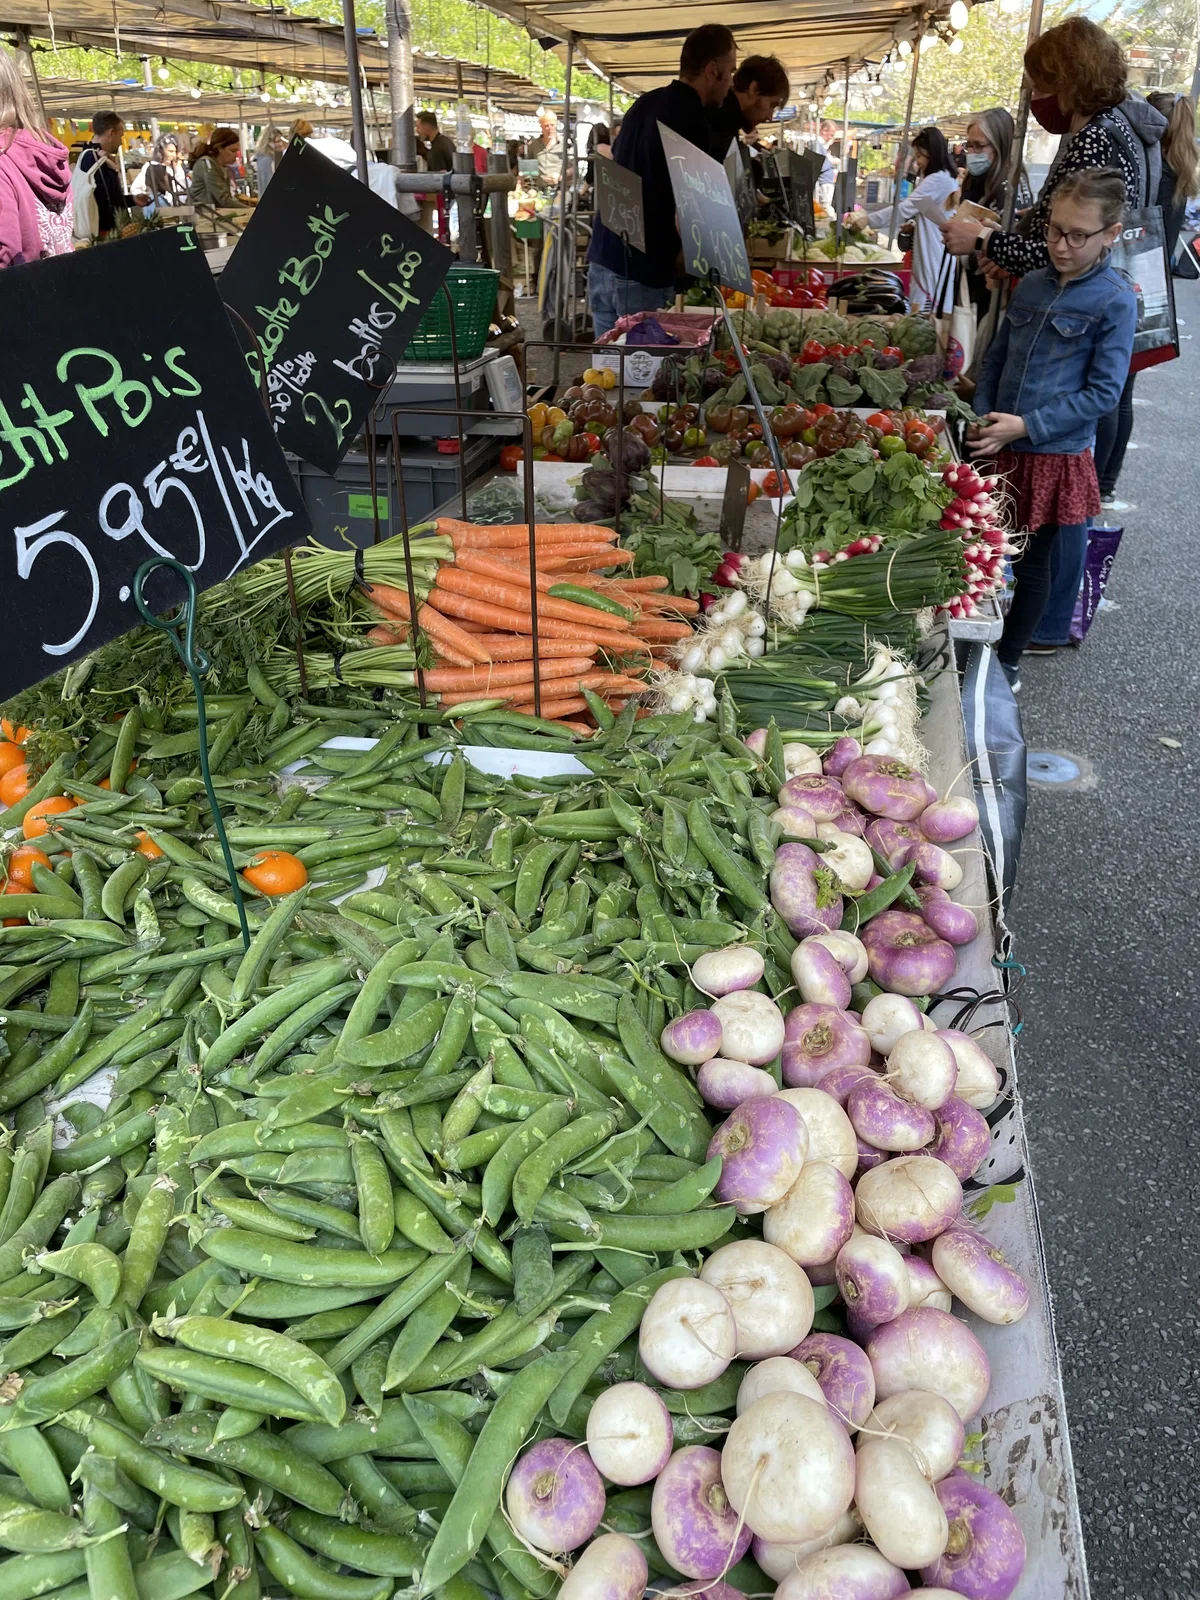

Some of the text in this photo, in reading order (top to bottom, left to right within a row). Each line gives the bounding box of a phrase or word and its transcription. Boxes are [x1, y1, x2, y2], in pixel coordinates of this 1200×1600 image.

[244, 204, 350, 389] arotte Botte
[56, 346, 203, 438] Pois
[289, 351, 318, 387] botte
[301, 391, 352, 451] 2
[332, 301, 397, 382] bottes
